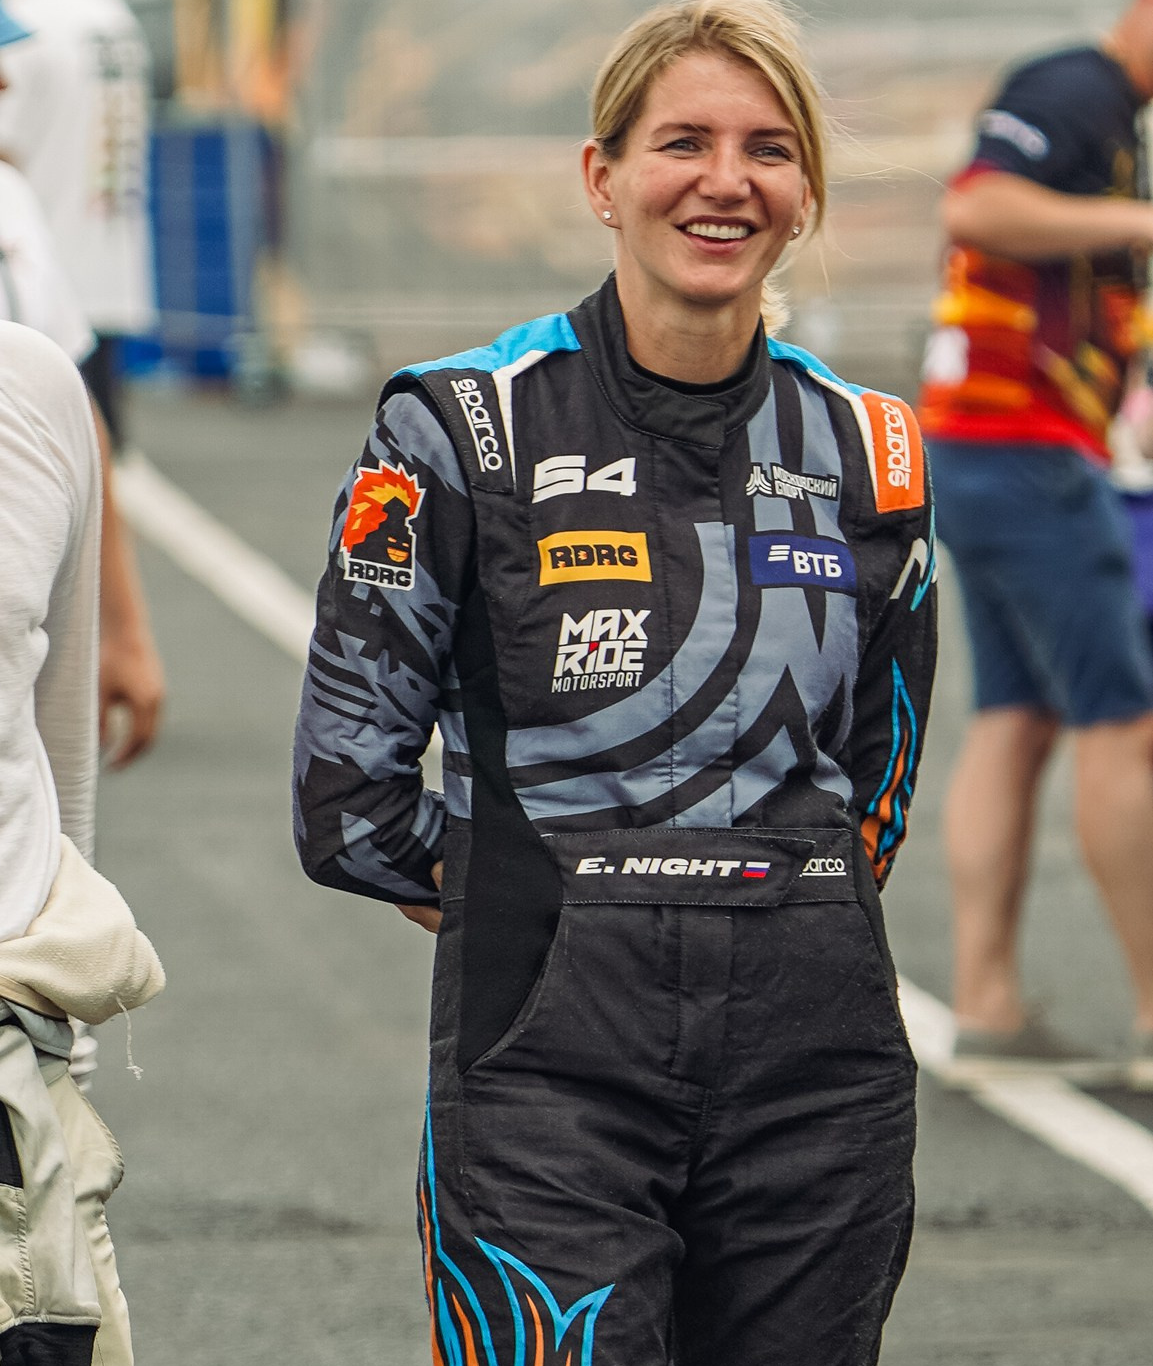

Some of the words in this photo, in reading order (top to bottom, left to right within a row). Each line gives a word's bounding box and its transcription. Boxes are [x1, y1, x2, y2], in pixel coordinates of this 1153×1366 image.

[451, 378, 503, 473] sparco
[880, 401, 912, 490] sparco
[548, 543, 639, 569] RDRC
[792, 550, 843, 578] ВТБ
[348, 560, 413, 586] RDRC
[559, 608, 651, 645] MAX
[551, 671, 643, 694] MOTORSPORT
[576, 857, 615, 875] E.
[621, 857, 741, 877] NIGHT
